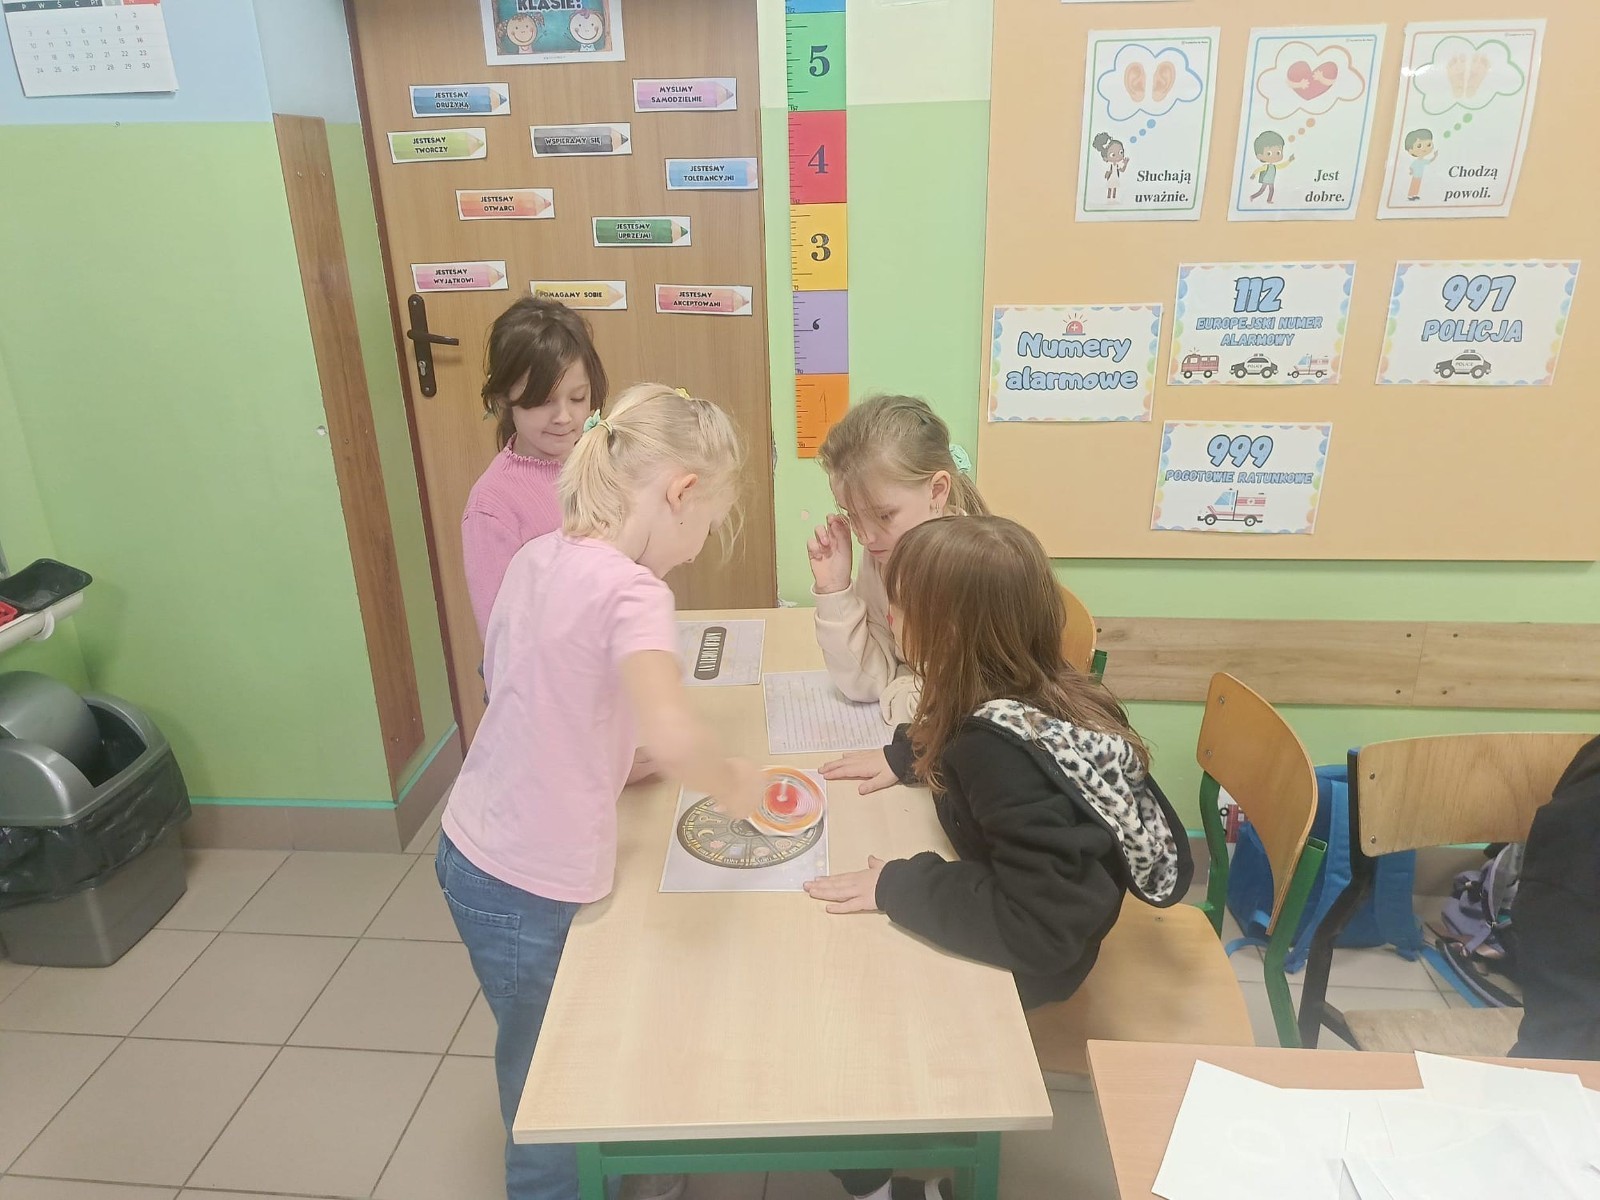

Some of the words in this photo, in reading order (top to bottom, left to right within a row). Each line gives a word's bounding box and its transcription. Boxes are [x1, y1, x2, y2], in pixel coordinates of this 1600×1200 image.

[809, 45, 830, 77] 5
[545, 137, 586, 145] WSPIERAMY
[808, 144, 829, 174] 4
[1136, 170, 1191, 184] Słuchają
[1314, 169, 1339, 182] Jest
[1448, 166, 1498, 180] Chodzą
[1135, 191, 1188, 202] uważnie.
[1305, 191, 1345, 203] dobre.
[1444, 188, 1491, 201] powoli.
[811, 233, 831, 261] 3
[1233, 277, 1285, 312] 112
[1442, 275, 1516, 311] 997
[1196, 317, 1275, 330] EUROPEJSKI
[1278, 316, 1323, 329] NUMER
[1421, 319, 1523, 342] POLICJA
[1018, 332, 1131, 362] Numery
[1221, 334, 1295, 346] ALARMOWY
[1006, 366, 1138, 390] alarmowe
[1207, 434, 1273, 468] 999
[1165, 470, 1235, 483] POGOTOWIE
[1237, 472, 1313, 484] RATUNKOWE
